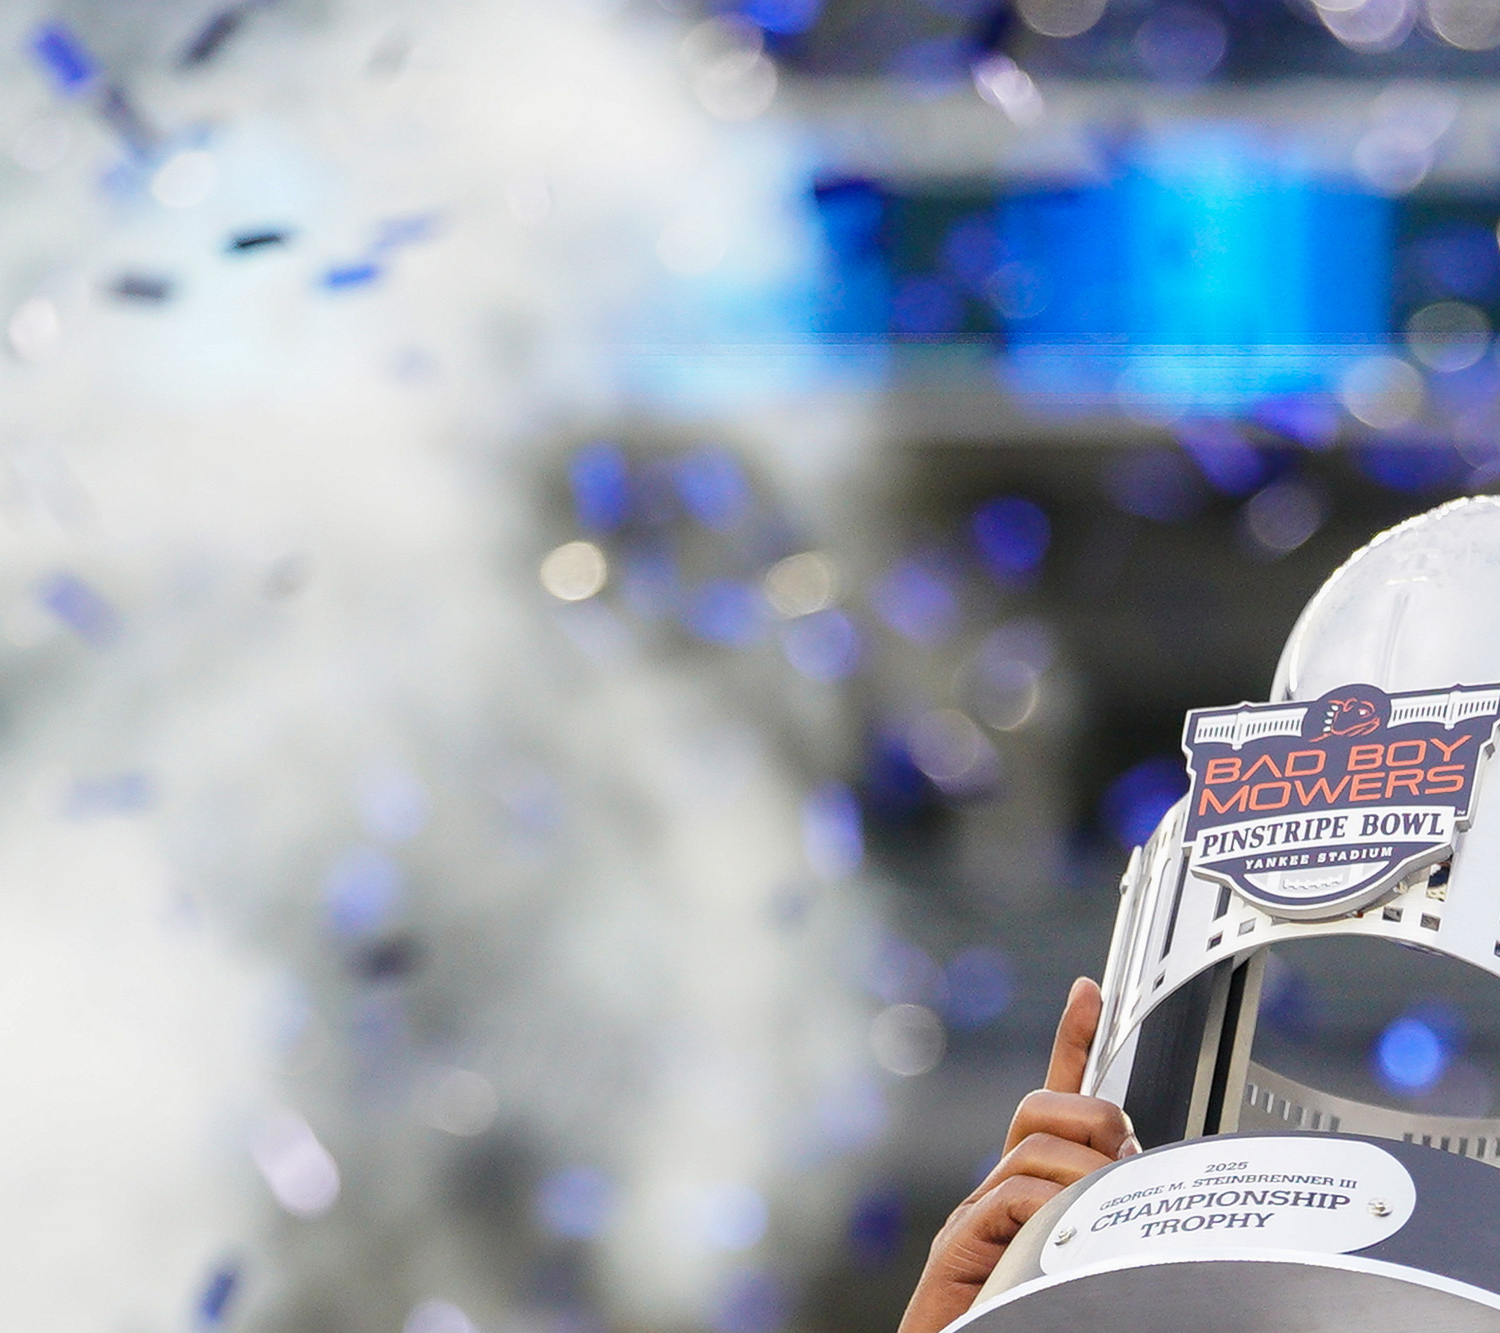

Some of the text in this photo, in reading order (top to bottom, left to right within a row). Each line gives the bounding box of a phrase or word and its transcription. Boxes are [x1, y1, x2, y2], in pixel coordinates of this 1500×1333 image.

[1204, 735, 1473, 785] BAD BOY
[1198, 764, 1466, 816] MOWERS
[1200, 812, 1445, 858] PINSTRIPE BOWL
[1244, 846, 1394, 870] YANKEE STADIUM
[1205, 1161, 1250, 1173] 2025
[1090, 1190, 1352, 1233] CHAMPIONSHIP
[1099, 1185, 1165, 1211] GEORGE
[1167, 1181, 1187, 1193] M.
[1192, 1174, 1334, 1188] STEINBRENNER
[1140, 1213, 1276, 1239] TROPHY
